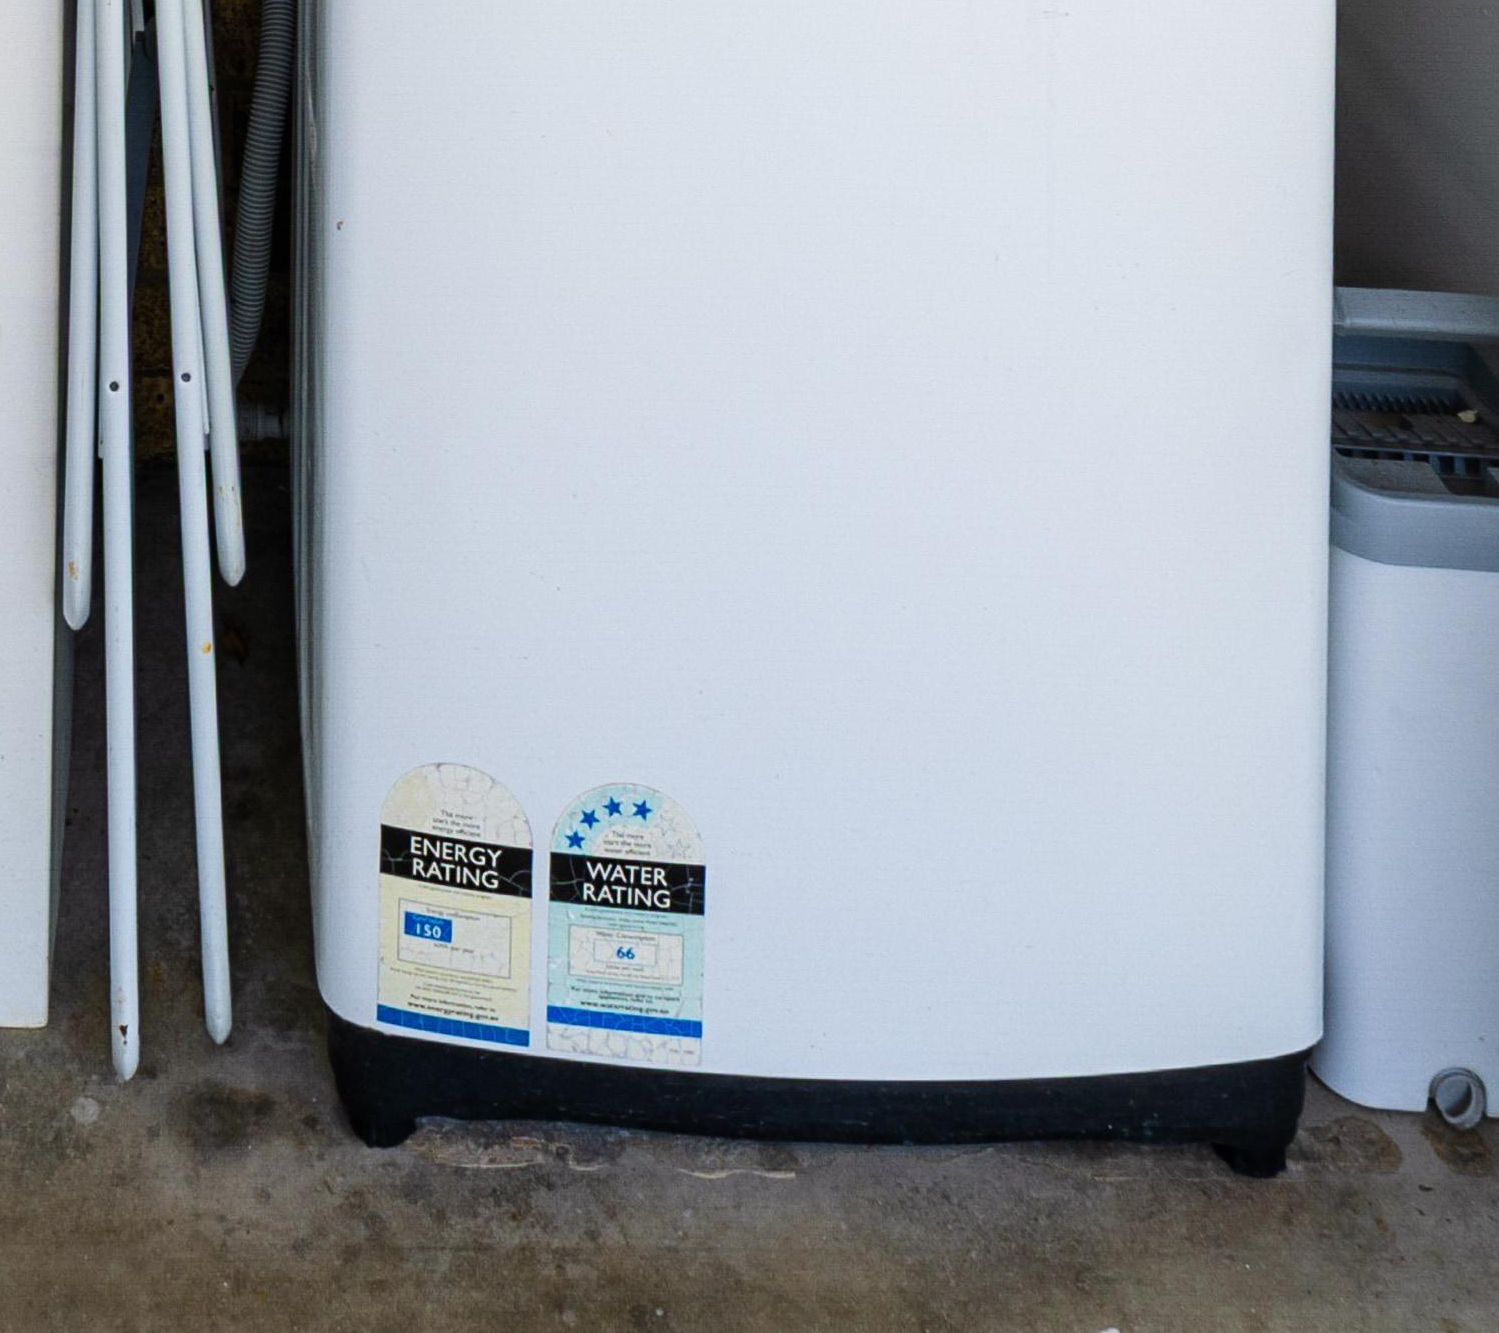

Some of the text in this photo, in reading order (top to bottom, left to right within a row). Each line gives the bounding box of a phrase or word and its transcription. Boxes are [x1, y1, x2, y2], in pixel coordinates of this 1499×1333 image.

[410, 836, 502, 868] ENERGY
[413, 858, 499, 889] RATING
[586, 861, 668, 887] WATER
[582, 882, 671, 909] RATING
[616, 946, 635, 960] 66
